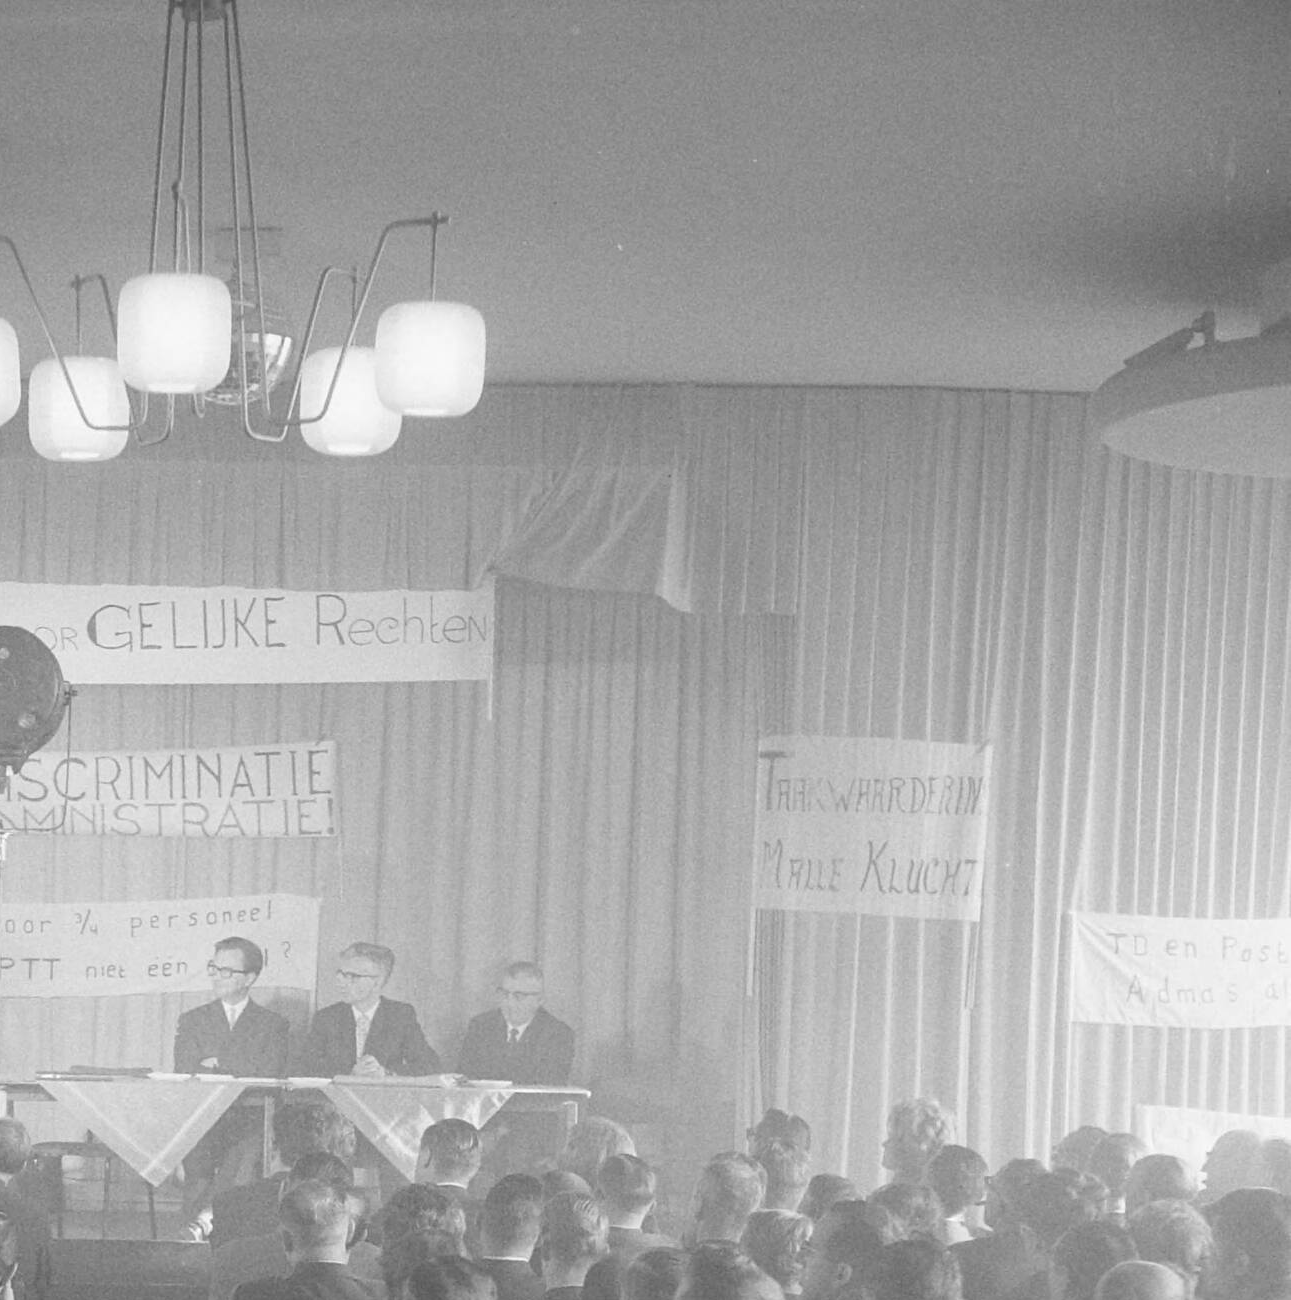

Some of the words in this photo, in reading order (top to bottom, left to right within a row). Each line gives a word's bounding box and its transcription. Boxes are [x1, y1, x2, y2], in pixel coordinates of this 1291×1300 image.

[86, 596, 286, 652] GELIJKE
[130, 899, 272, 938] personeel
[1106, 932, 1148, 957] TD
[1165, 938, 1198, 959] en
[85, 963, 127, 980] niet
